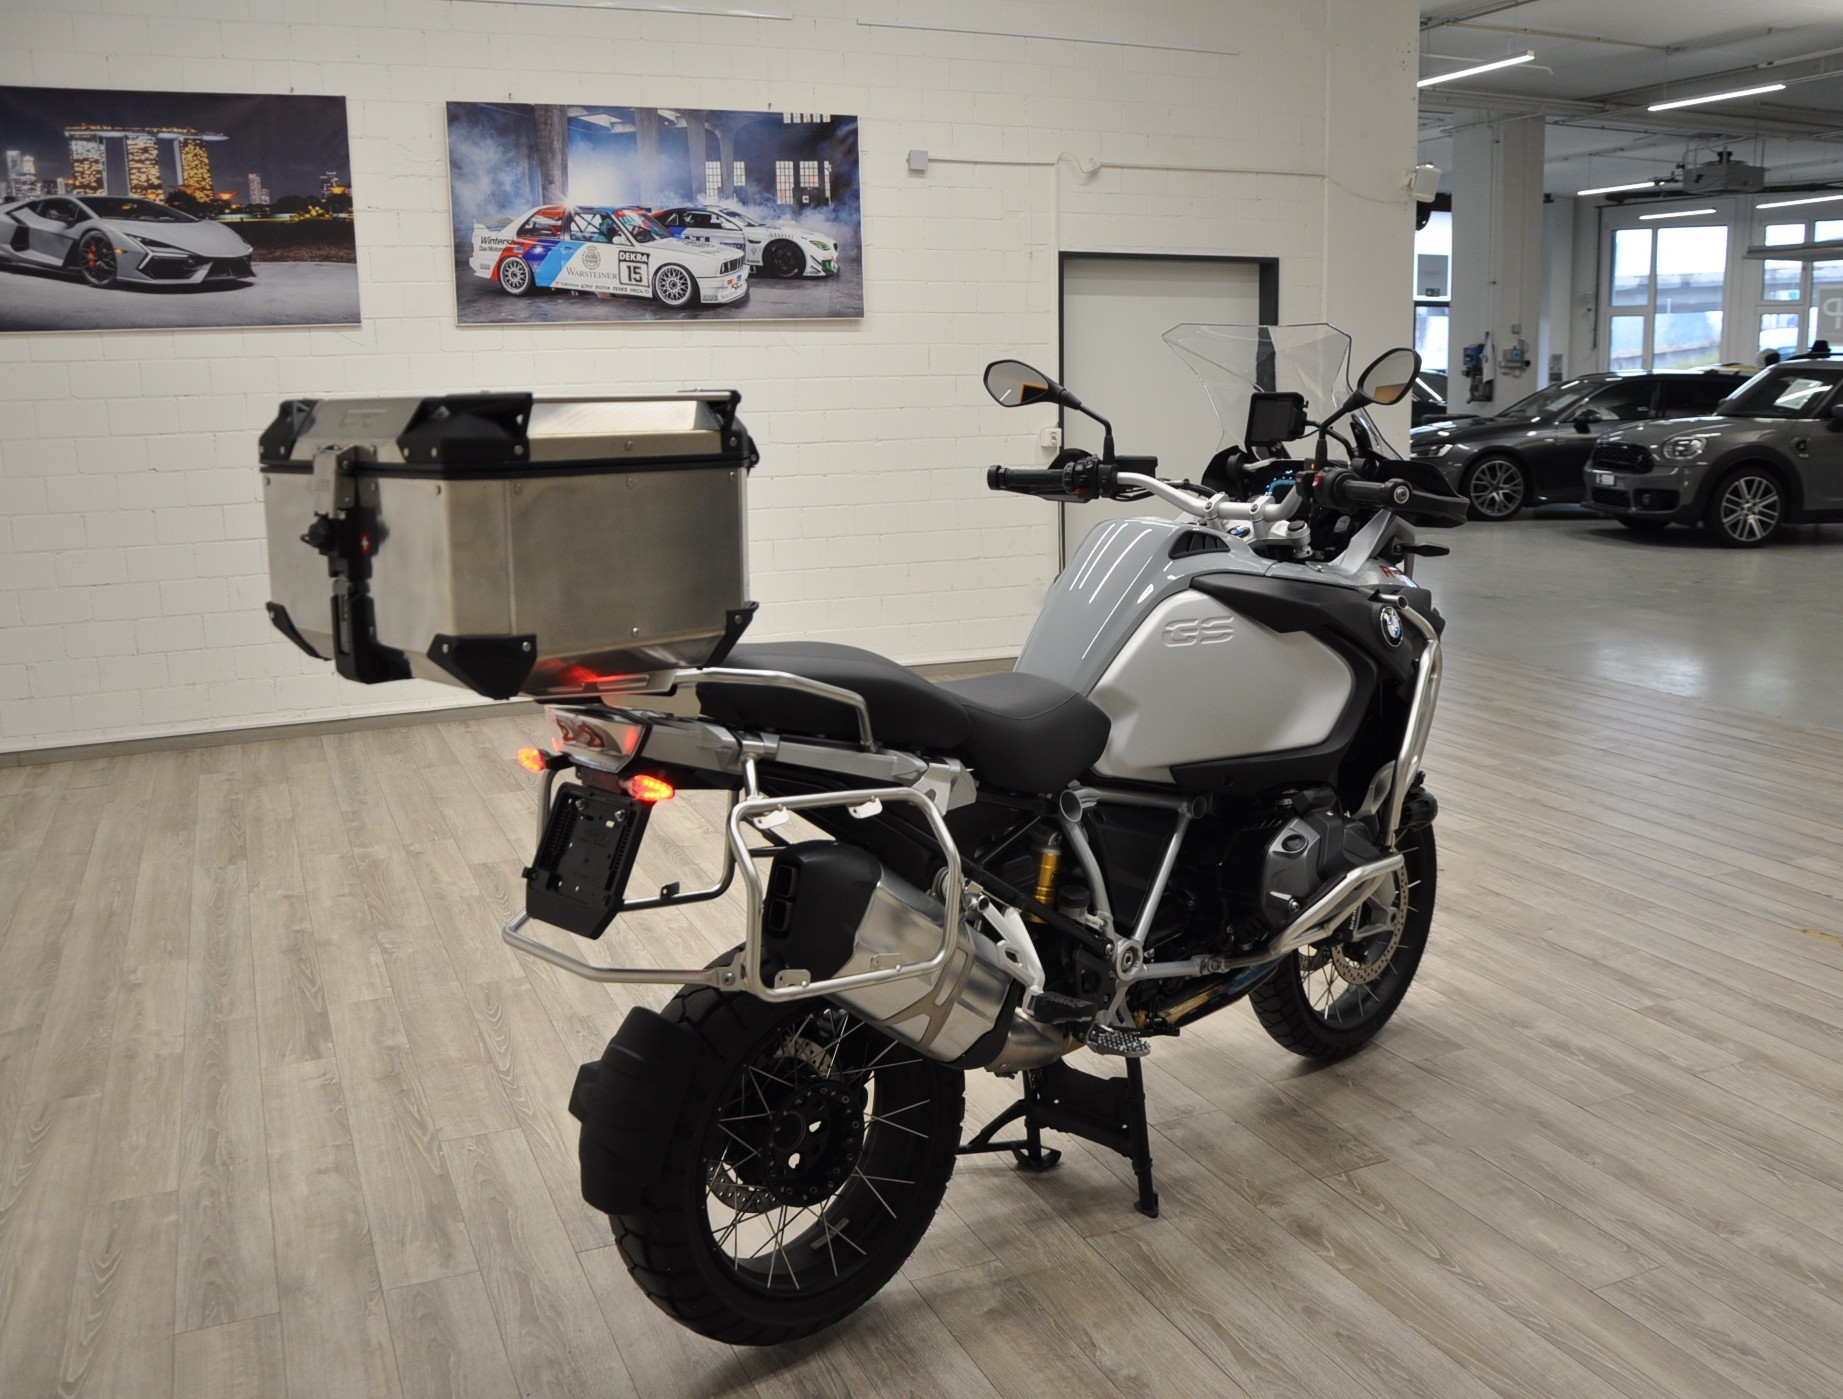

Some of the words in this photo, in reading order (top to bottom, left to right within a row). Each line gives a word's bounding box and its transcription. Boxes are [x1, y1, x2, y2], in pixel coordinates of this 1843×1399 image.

[620, 251, 648, 262] DEKRA
[566, 266, 618, 280] WARSTEINER
[626, 265, 643, 283] 15
[1161, 615, 1234, 648] GS
